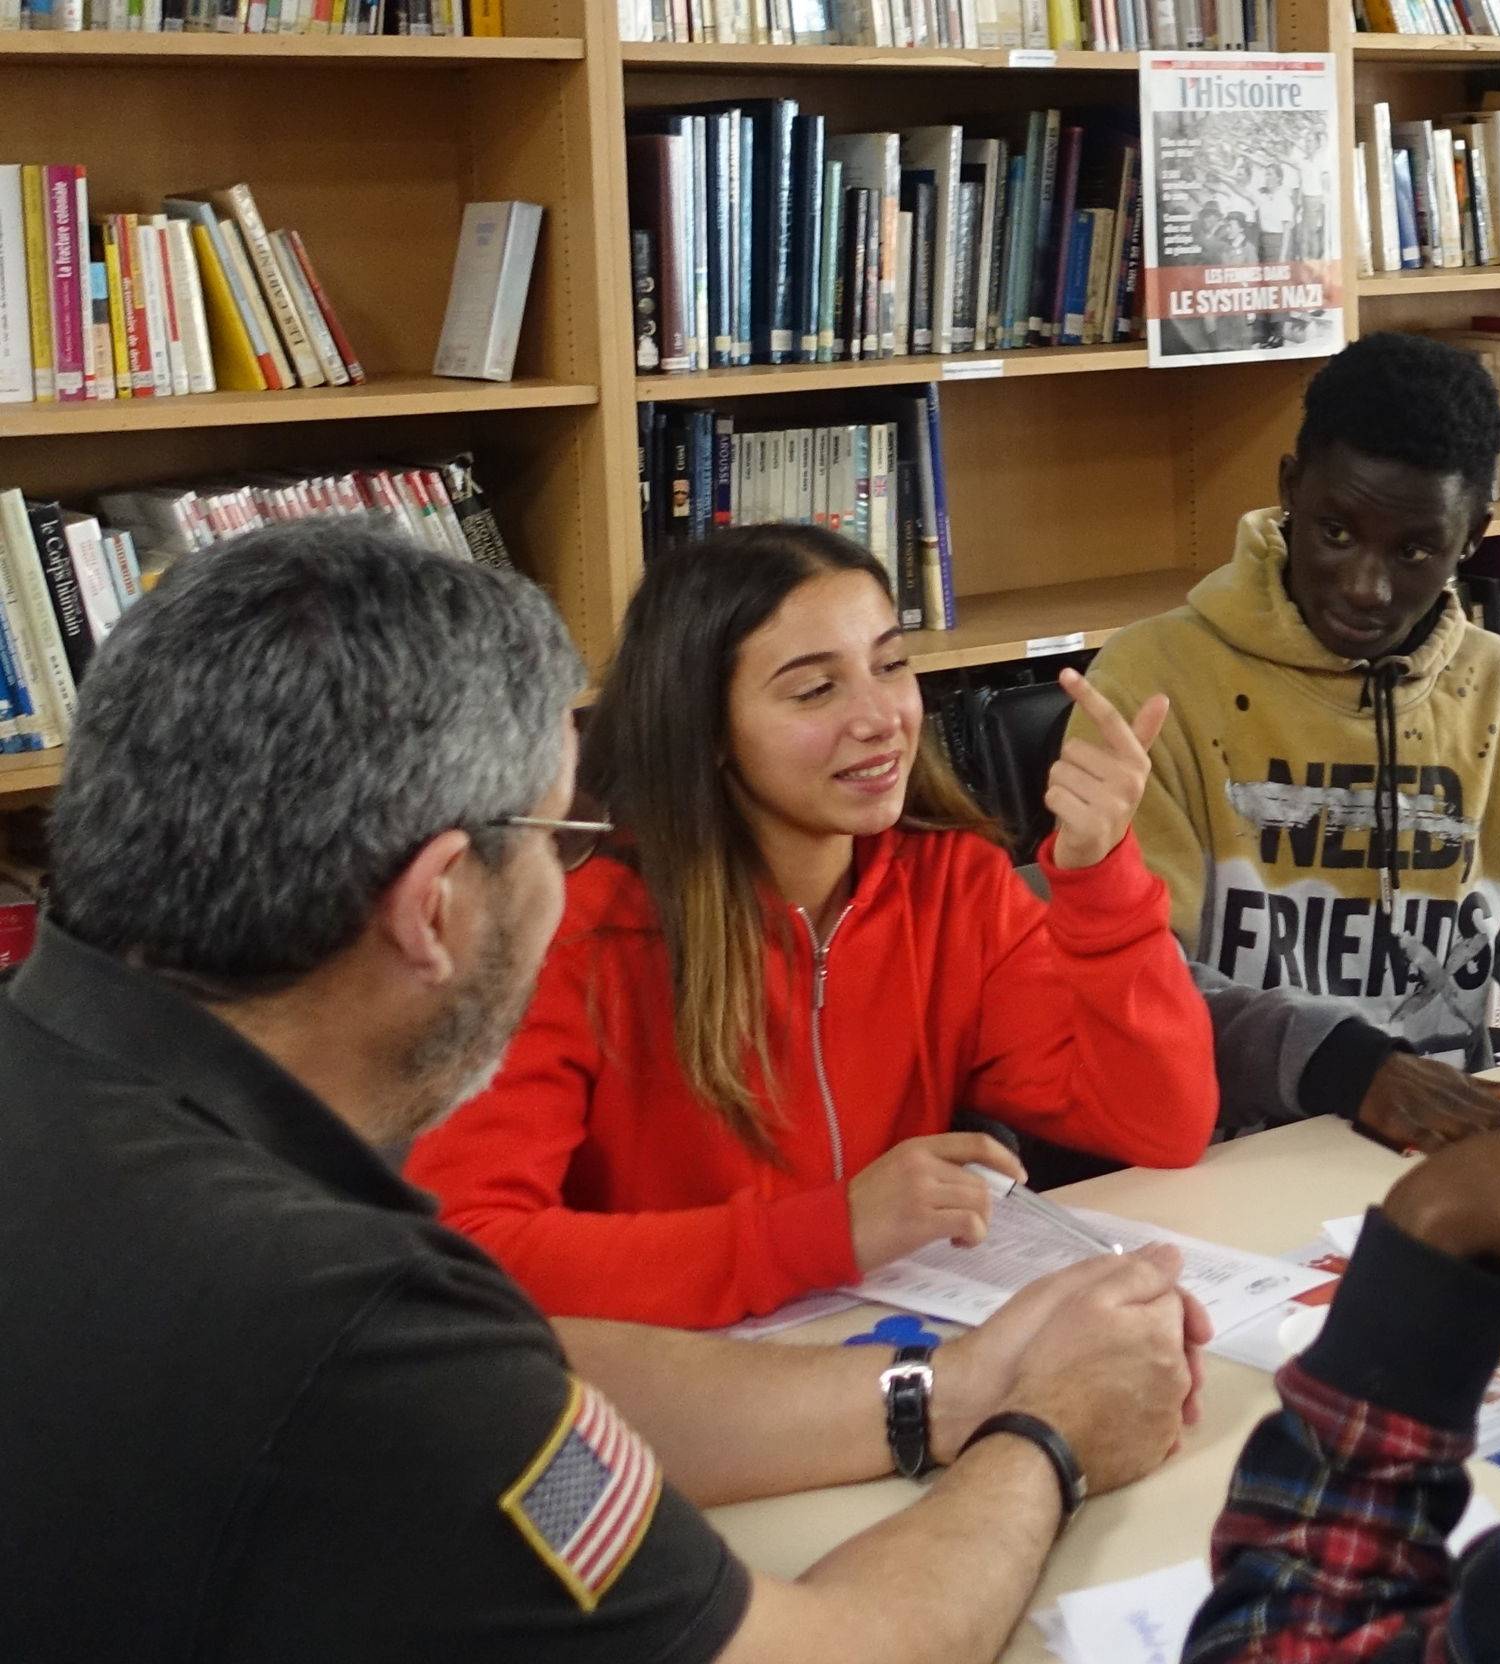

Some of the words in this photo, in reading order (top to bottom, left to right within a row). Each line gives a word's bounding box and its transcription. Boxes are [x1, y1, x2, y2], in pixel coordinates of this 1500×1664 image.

[1179, 75, 1302, 108] l'Histoire
[52, 181, 70, 224] coloniale
[54, 227, 72, 264] fracture
[56, 266, 72, 279] La
[1170, 291, 1195, 316] LE
[1196, 282, 1279, 314] SYSTÈME
[1281, 284, 1324, 310] NAZI
[717, 433, 732, 486] AROUSSE
[41, 517, 60, 536] le
[43, 534, 71, 586] Corps
[55, 580, 85, 637] humain
[1217, 887, 1494, 998] FRIENDS
